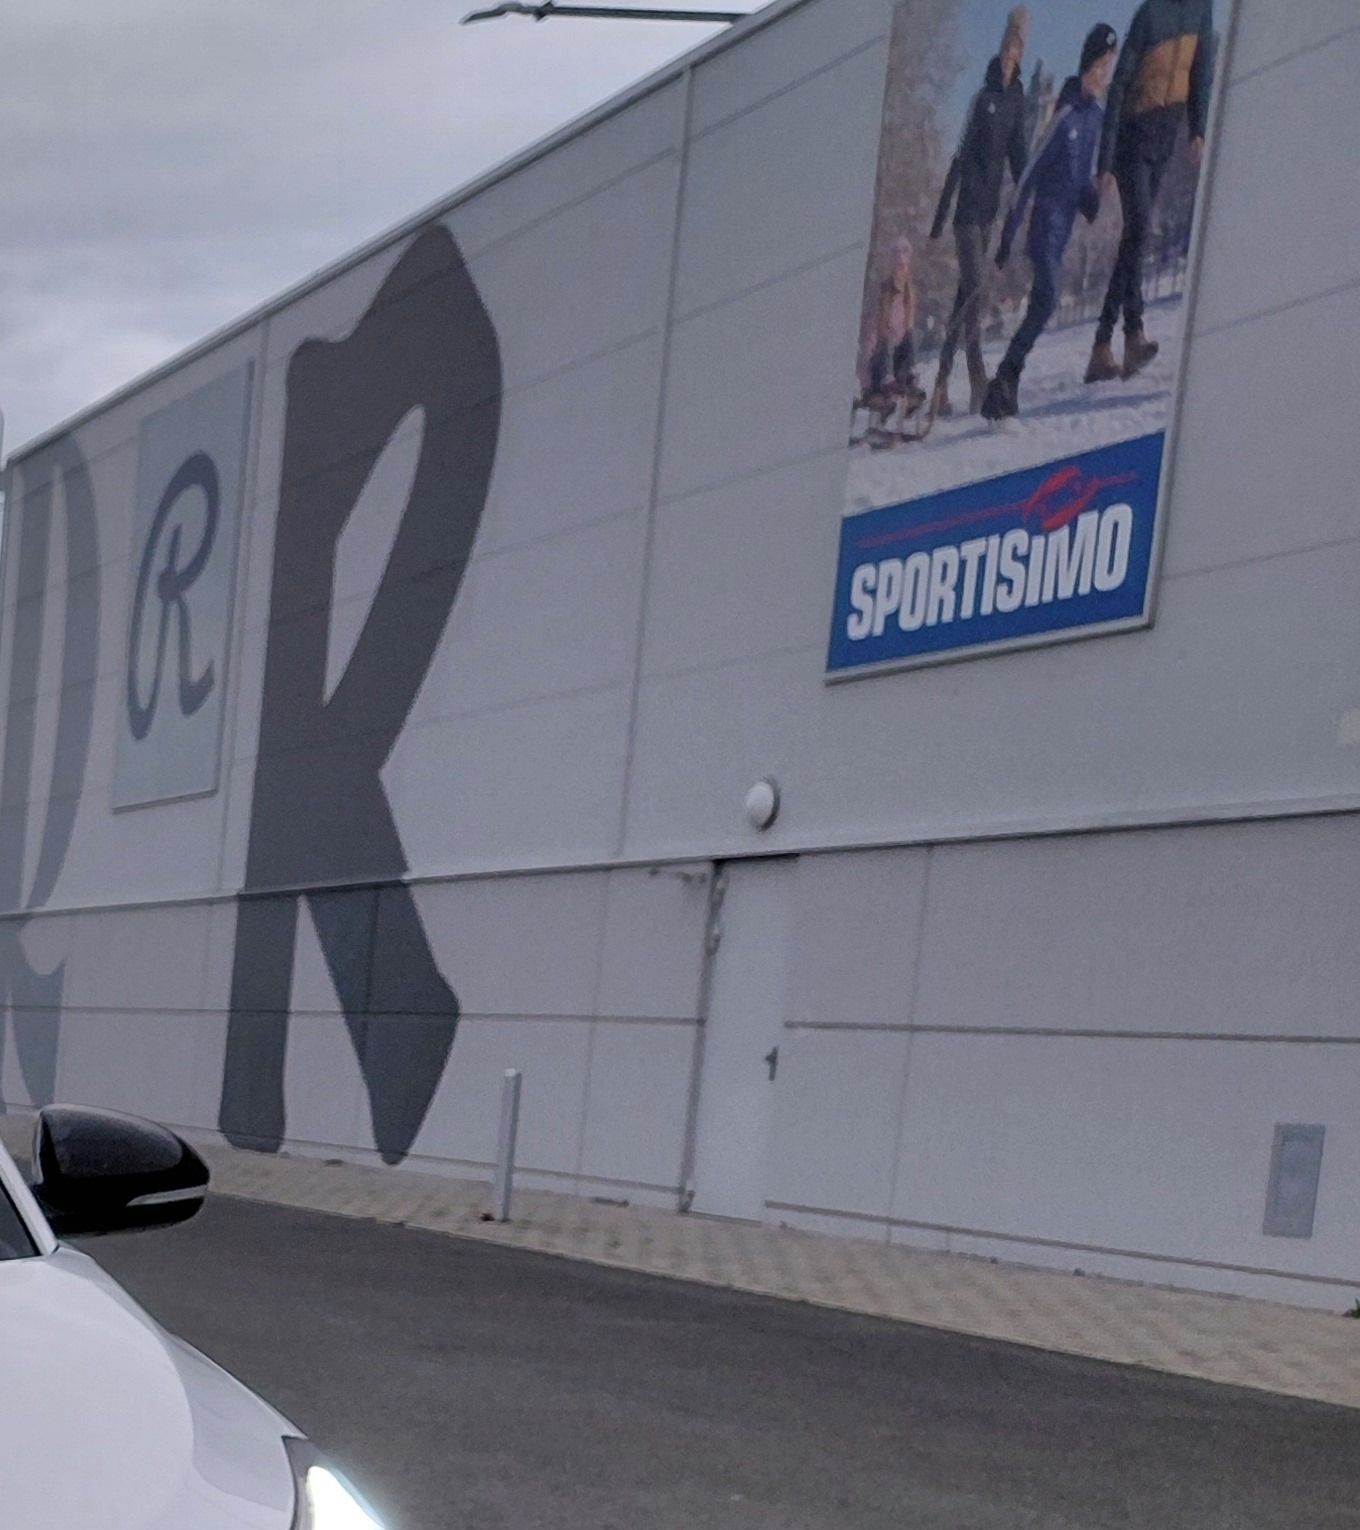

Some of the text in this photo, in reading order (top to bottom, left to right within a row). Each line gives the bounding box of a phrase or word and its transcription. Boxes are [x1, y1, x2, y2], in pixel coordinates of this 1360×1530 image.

[125, 449, 221, 741] R
[218, 224, 504, 1166] R
[846, 502, 1133, 641] SPORTISIMO
